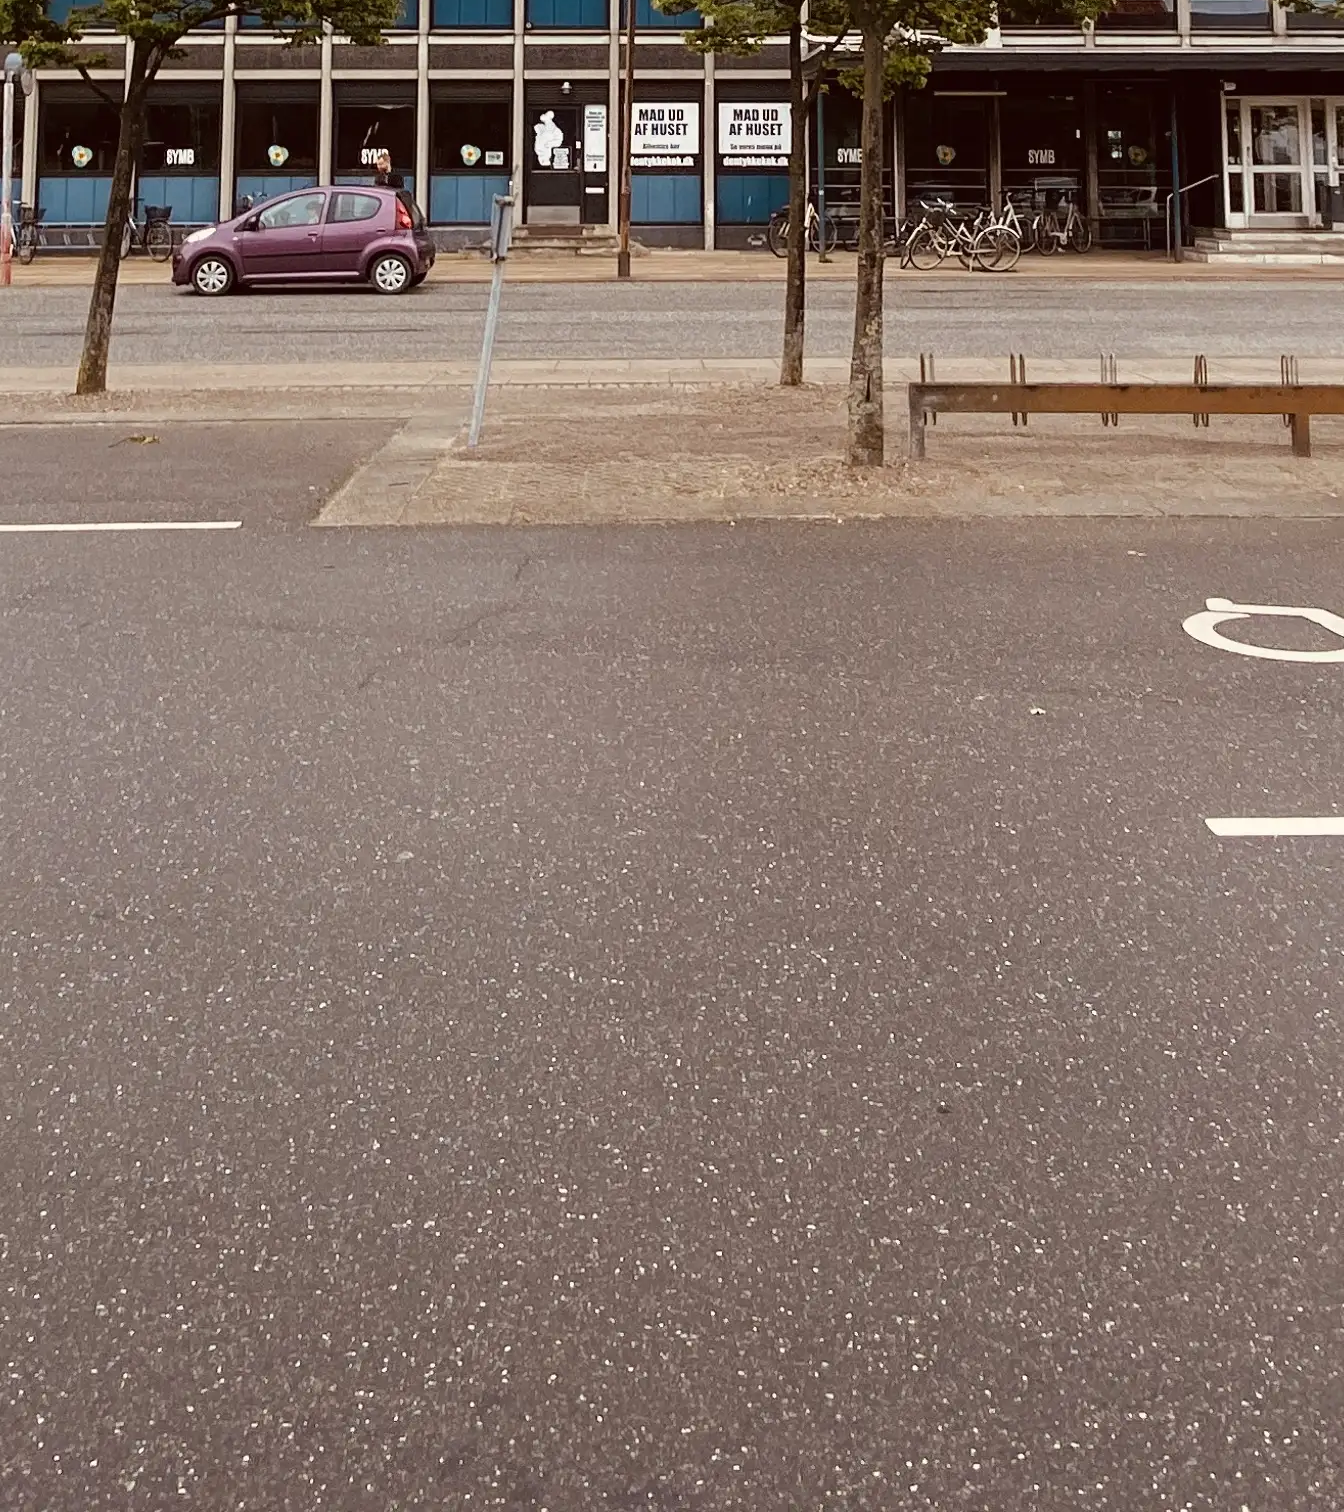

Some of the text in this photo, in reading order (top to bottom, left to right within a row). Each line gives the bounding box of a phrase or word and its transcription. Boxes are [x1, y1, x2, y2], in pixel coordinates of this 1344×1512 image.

[638, 109, 684, 121] MAD UD
[733, 109, 778, 121] MAD UD
[634, 123, 688, 136] AF HUSET
[729, 123, 783, 136] AF HUSET
[166, 149, 195, 165] SYMB
[1028, 149, 1055, 164] SYMB
